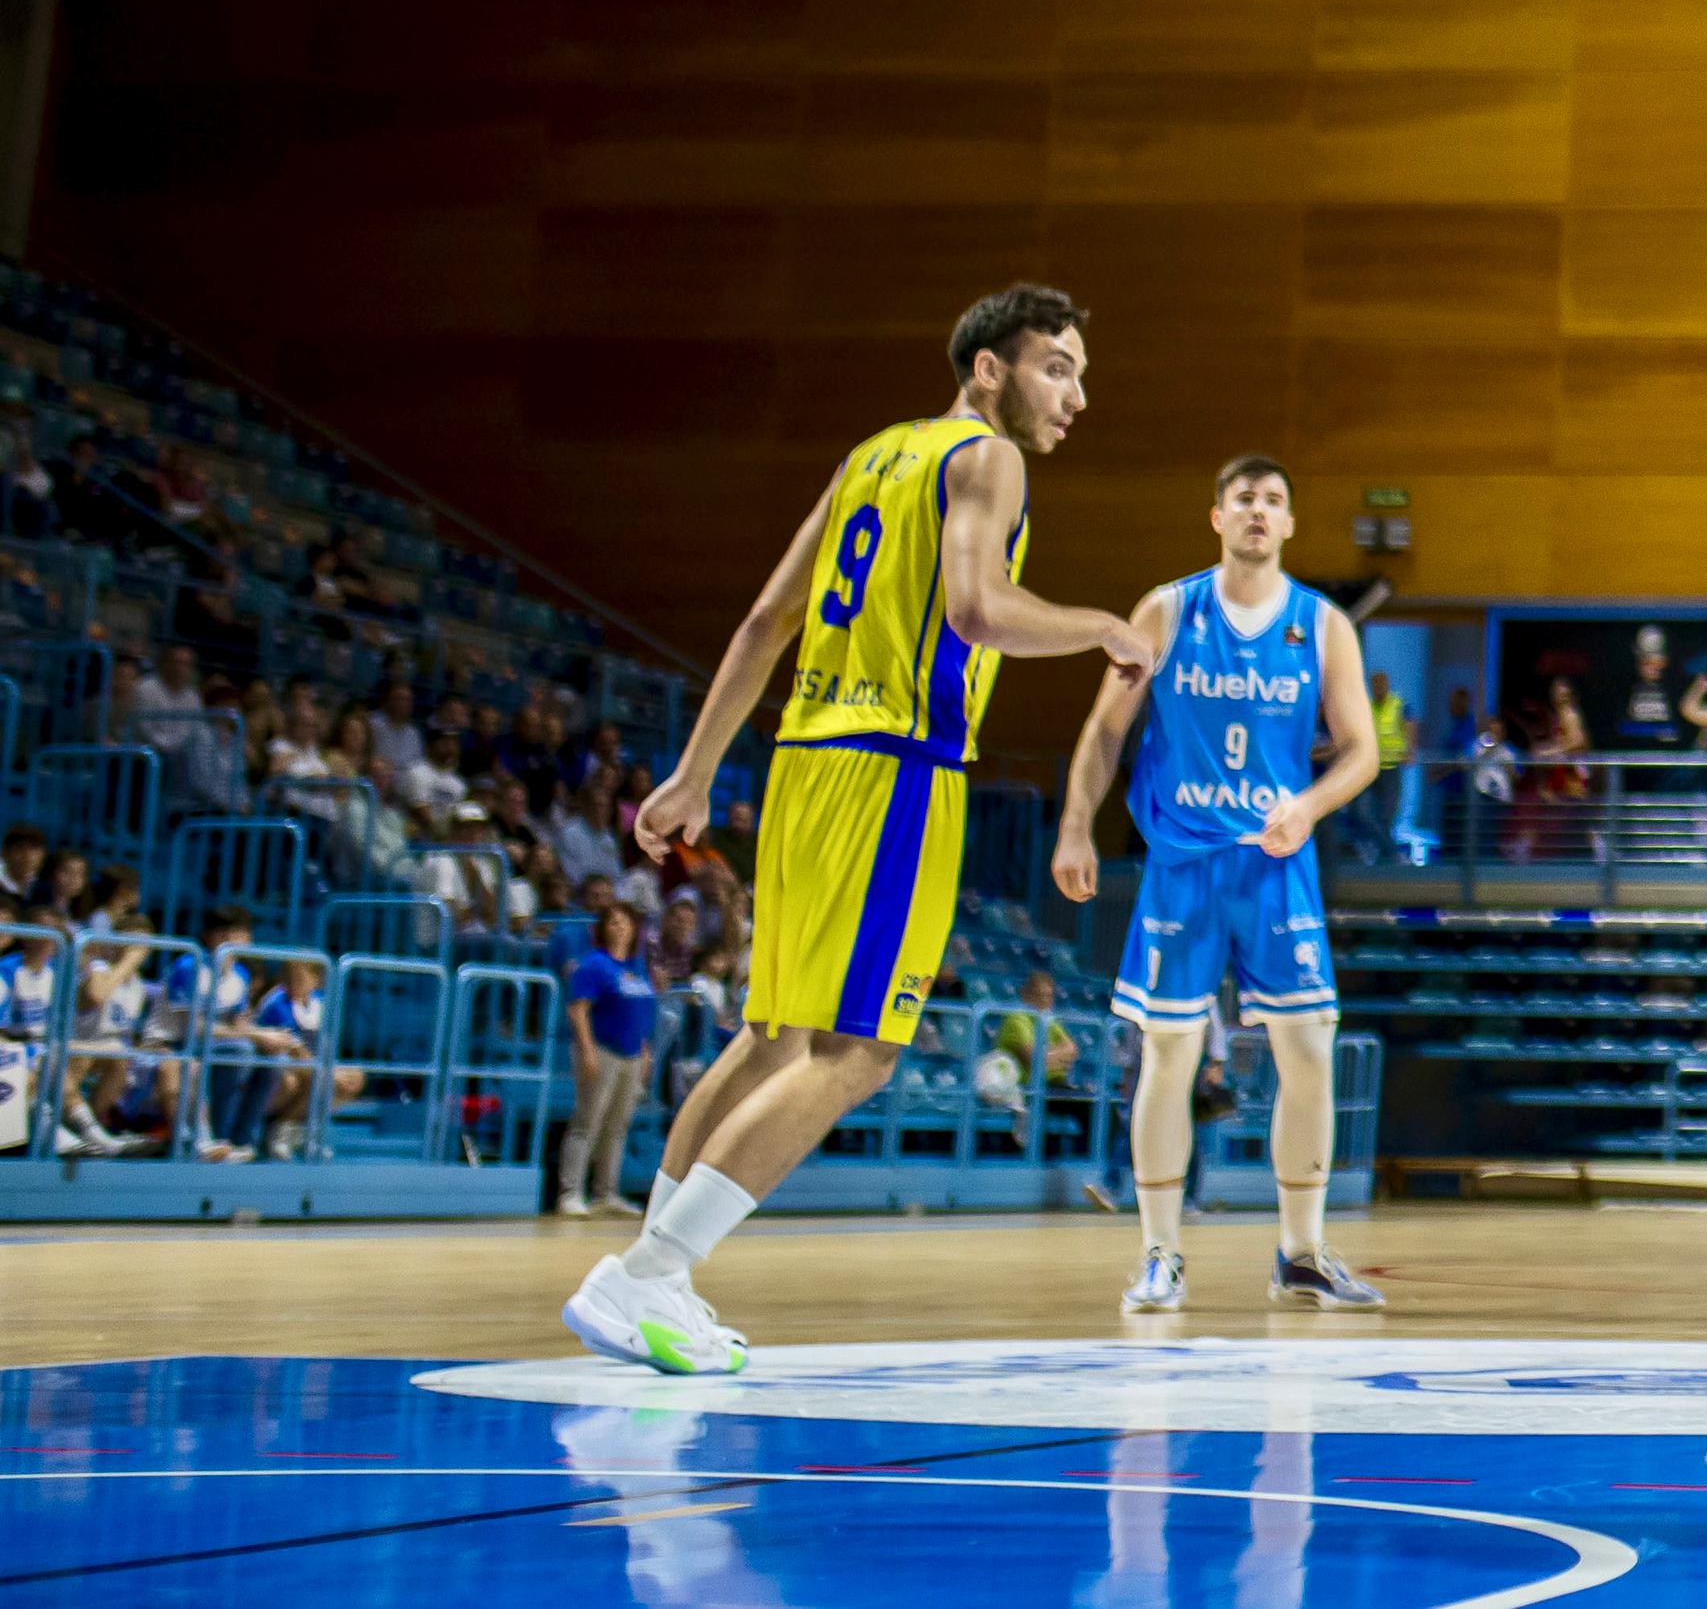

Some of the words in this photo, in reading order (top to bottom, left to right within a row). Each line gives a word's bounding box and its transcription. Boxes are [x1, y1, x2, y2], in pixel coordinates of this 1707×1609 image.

[820, 503, 882, 629] 9
[1174, 660, 1300, 704] Huelva
[1223, 722, 1248, 770] 9
